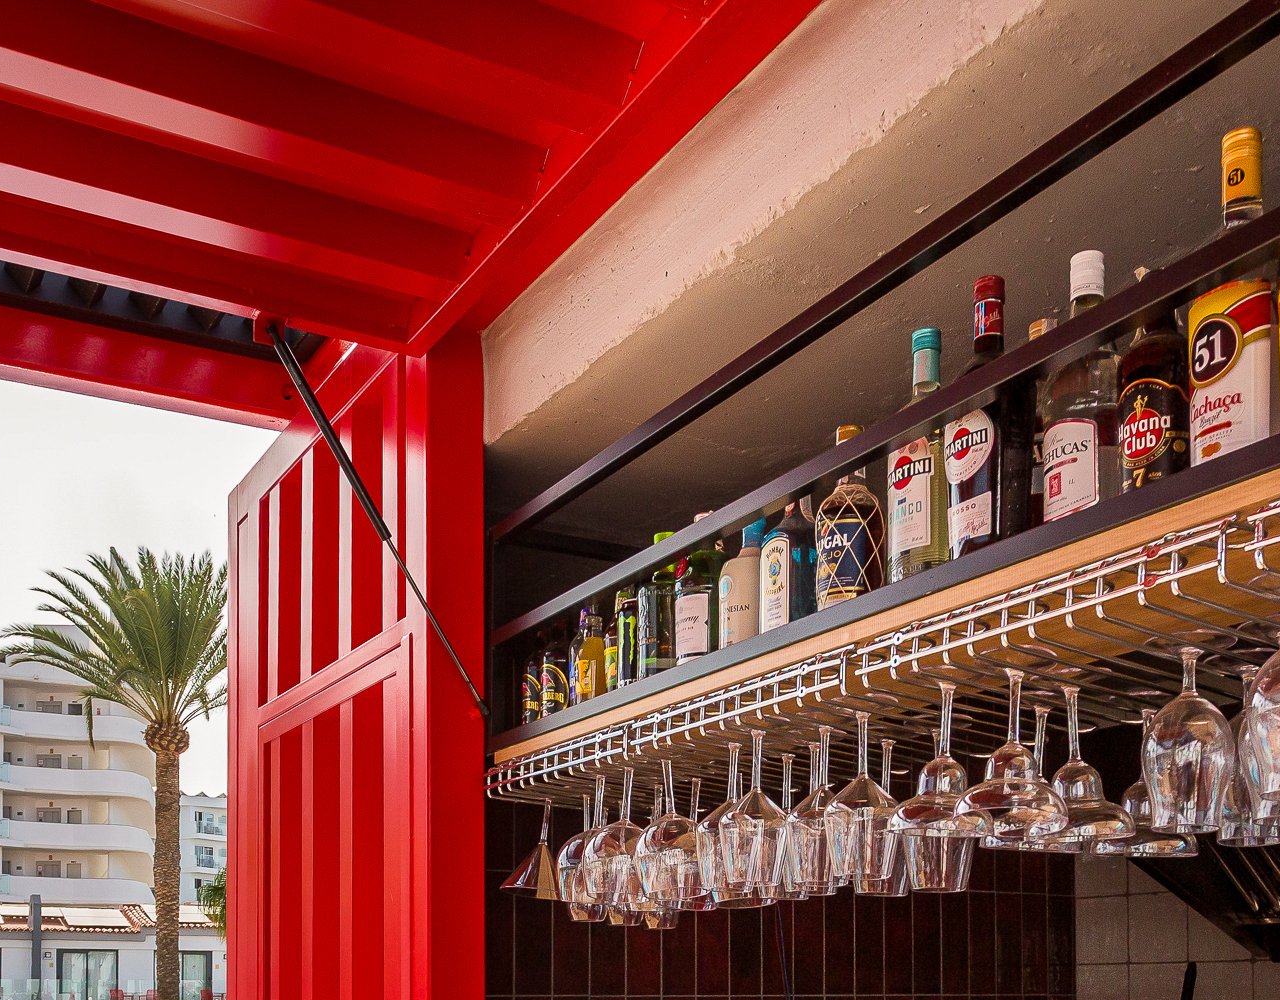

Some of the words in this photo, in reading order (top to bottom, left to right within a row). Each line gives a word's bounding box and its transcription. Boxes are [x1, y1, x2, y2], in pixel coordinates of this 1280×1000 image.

[1194, 329, 1227, 373] 51
[1191, 392, 1243, 424] Cachaça
[1118, 415, 1171, 443] Havana
[1124, 431, 1157, 455] Club
[945, 429, 987, 458] MARTINI
[888, 458, 931, 489] MARTINI
[1133, 467, 1146, 488] 7
[819, 533, 851, 549] UGAL
[822, 550, 841, 561] EJO
